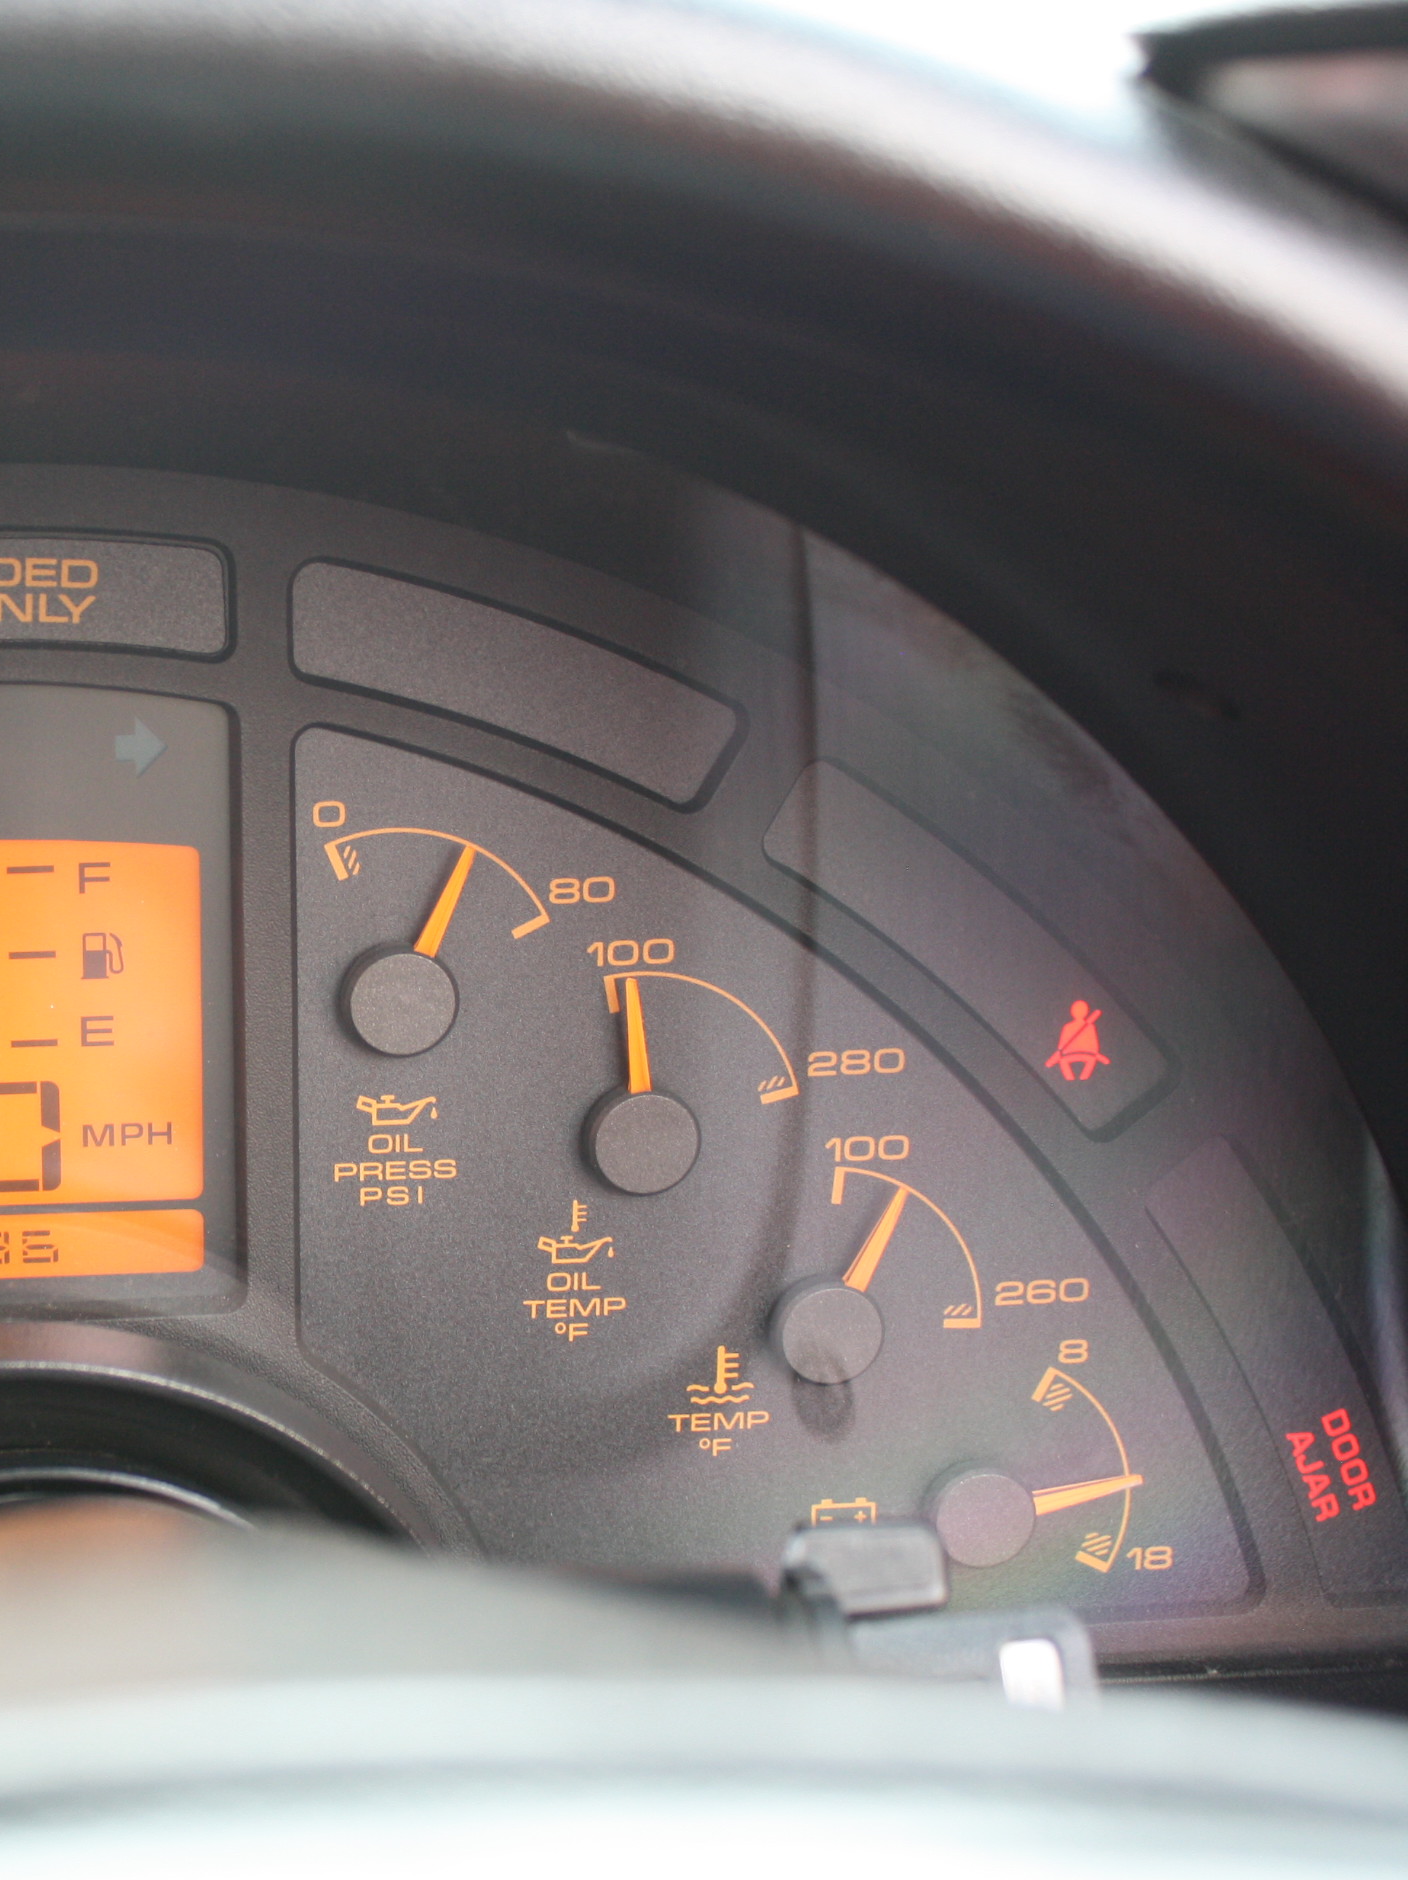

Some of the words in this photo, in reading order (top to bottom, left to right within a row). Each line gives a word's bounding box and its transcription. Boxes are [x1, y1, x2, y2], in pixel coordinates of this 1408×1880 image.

[312, 800, 347, 828] 0
[79, 862, 110, 893] F
[549, 876, 617, 905] 80
[587, 938, 676, 967] 100
[81, 1016, 113, 1046] E
[807, 1048, 906, 1077] 280
[83, 1122, 172, 1147] MPH
[367, 1133, 424, 1154] OIL
[826, 1135, 911, 1163] 100
[334, 1159, 458, 1182] PRESS
[359, 1185, 425, 1206] PSI
[546, 1272, 602, 1292] OIL
[995, 1278, 1090, 1306] 260
[523, 1297, 628, 1319] TEMP
[1058, 1339, 1089, 1365] 8
[668, 1411, 771, 1432] TEMP
[1321, 1408, 1377, 1512] DOOR
[1286, 1430, 1341, 1523] AJAR
[1127, 1546, 1174, 1570] 18
